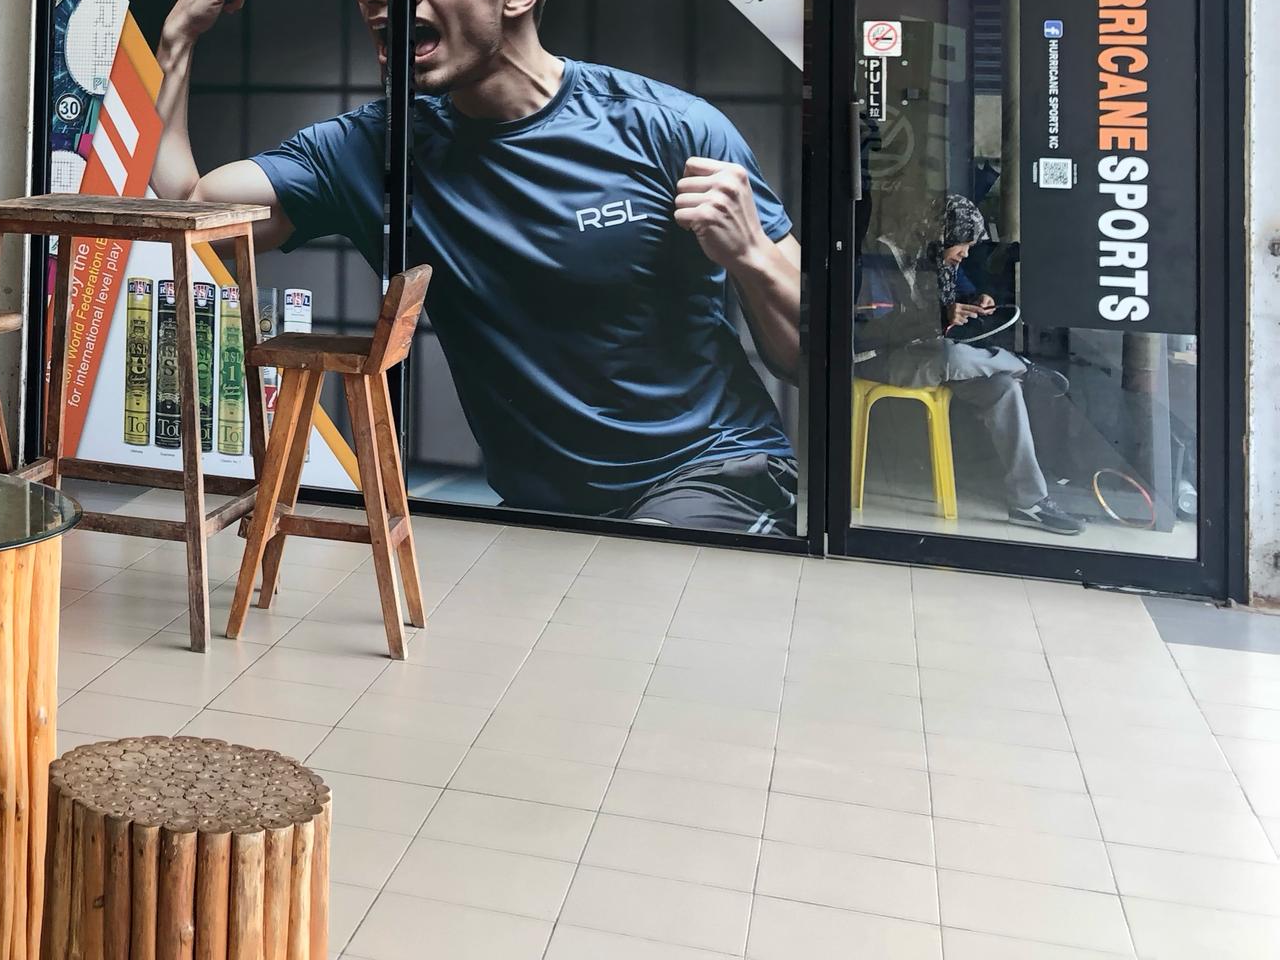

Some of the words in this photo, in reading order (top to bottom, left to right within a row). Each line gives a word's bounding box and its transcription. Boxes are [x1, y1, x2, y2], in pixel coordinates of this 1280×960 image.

[870, 59, 881, 106] PULL
[1048, 40, 1059, 95] HURRICANE
[60, 101, 78, 115] 30
[1048, 96, 1059, 134] SPORTS
[1048, 135, 1059, 149] KC
[576, 200, 648, 232] RSL
[73, 243, 90, 273] the
[1097, 155, 1150, 322] SPORTS
[76, 251, 103, 320] Federation
[67, 388, 82, 408] for
[76, 306, 105, 387] international
[97, 271, 114, 306] level
[106, 242, 124, 272] play
[67, 321, 86, 361] World
